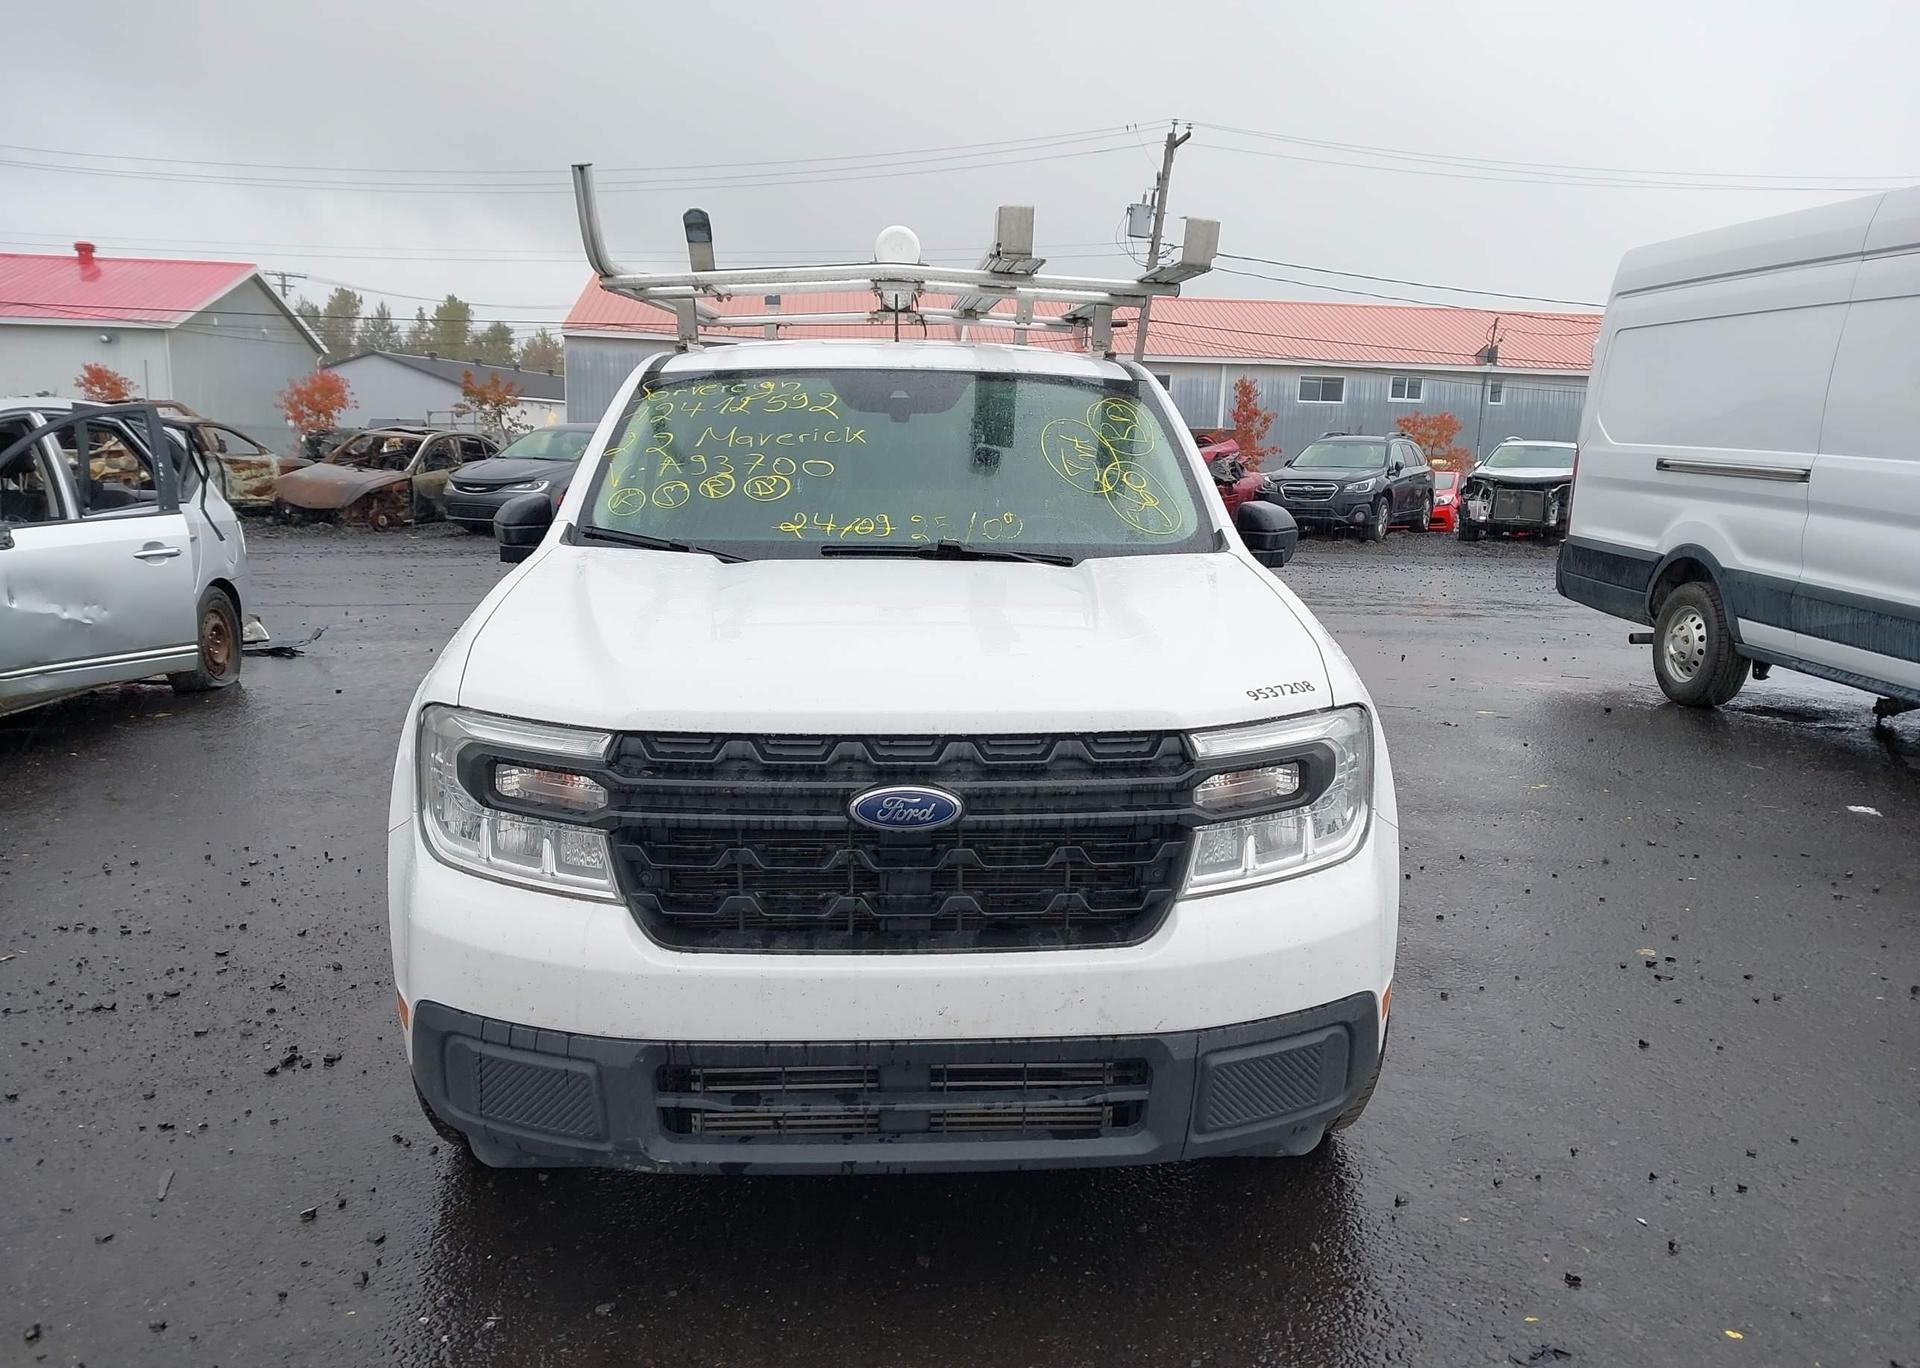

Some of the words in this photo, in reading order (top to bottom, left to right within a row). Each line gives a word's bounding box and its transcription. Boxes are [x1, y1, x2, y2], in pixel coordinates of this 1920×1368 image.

[697, 426, 866, 447] Maverick
[1246, 681, 1316, 701] 9537208
[876, 796, 937, 821] Ford
